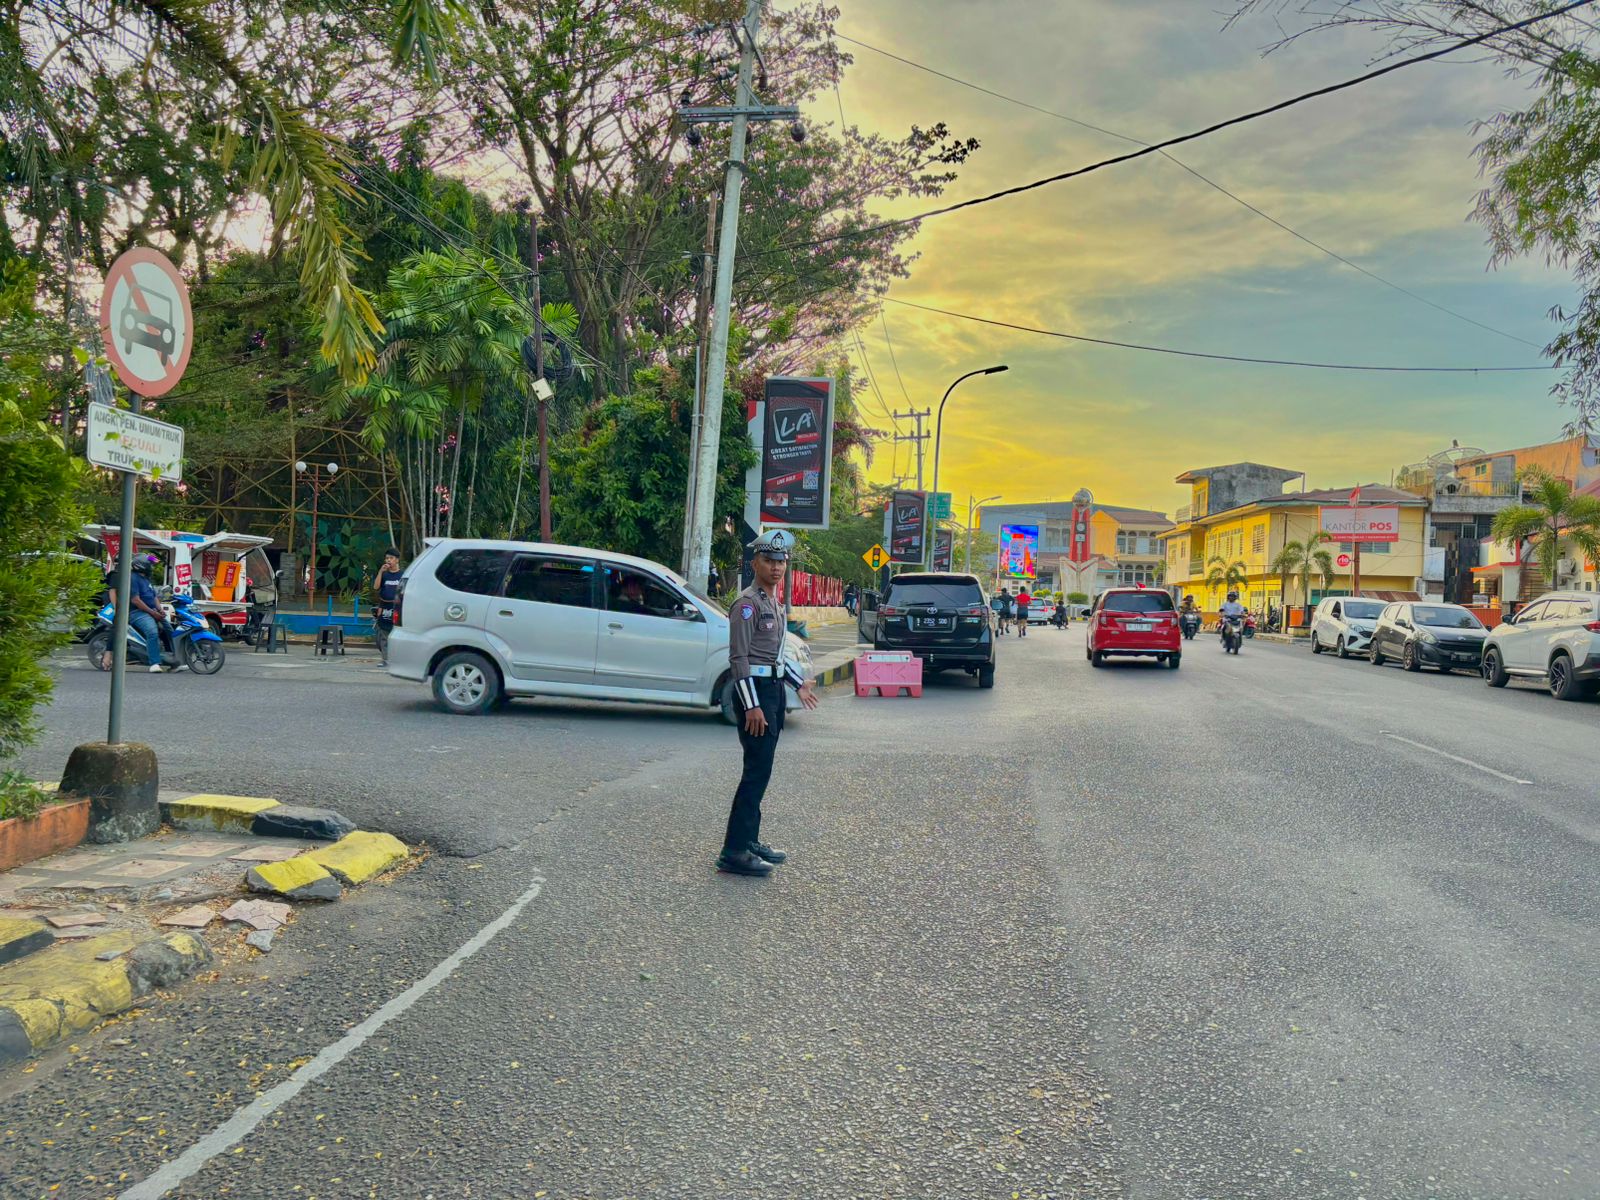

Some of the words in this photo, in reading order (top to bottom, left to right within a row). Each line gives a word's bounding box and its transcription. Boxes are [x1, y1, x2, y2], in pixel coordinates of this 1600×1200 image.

[107, 450, 135, 466] TRUK
[772, 452, 800, 460] STRONGER
[1325, 522, 1367, 531] KANTOR
[1369, 521, 1393, 531] POS
